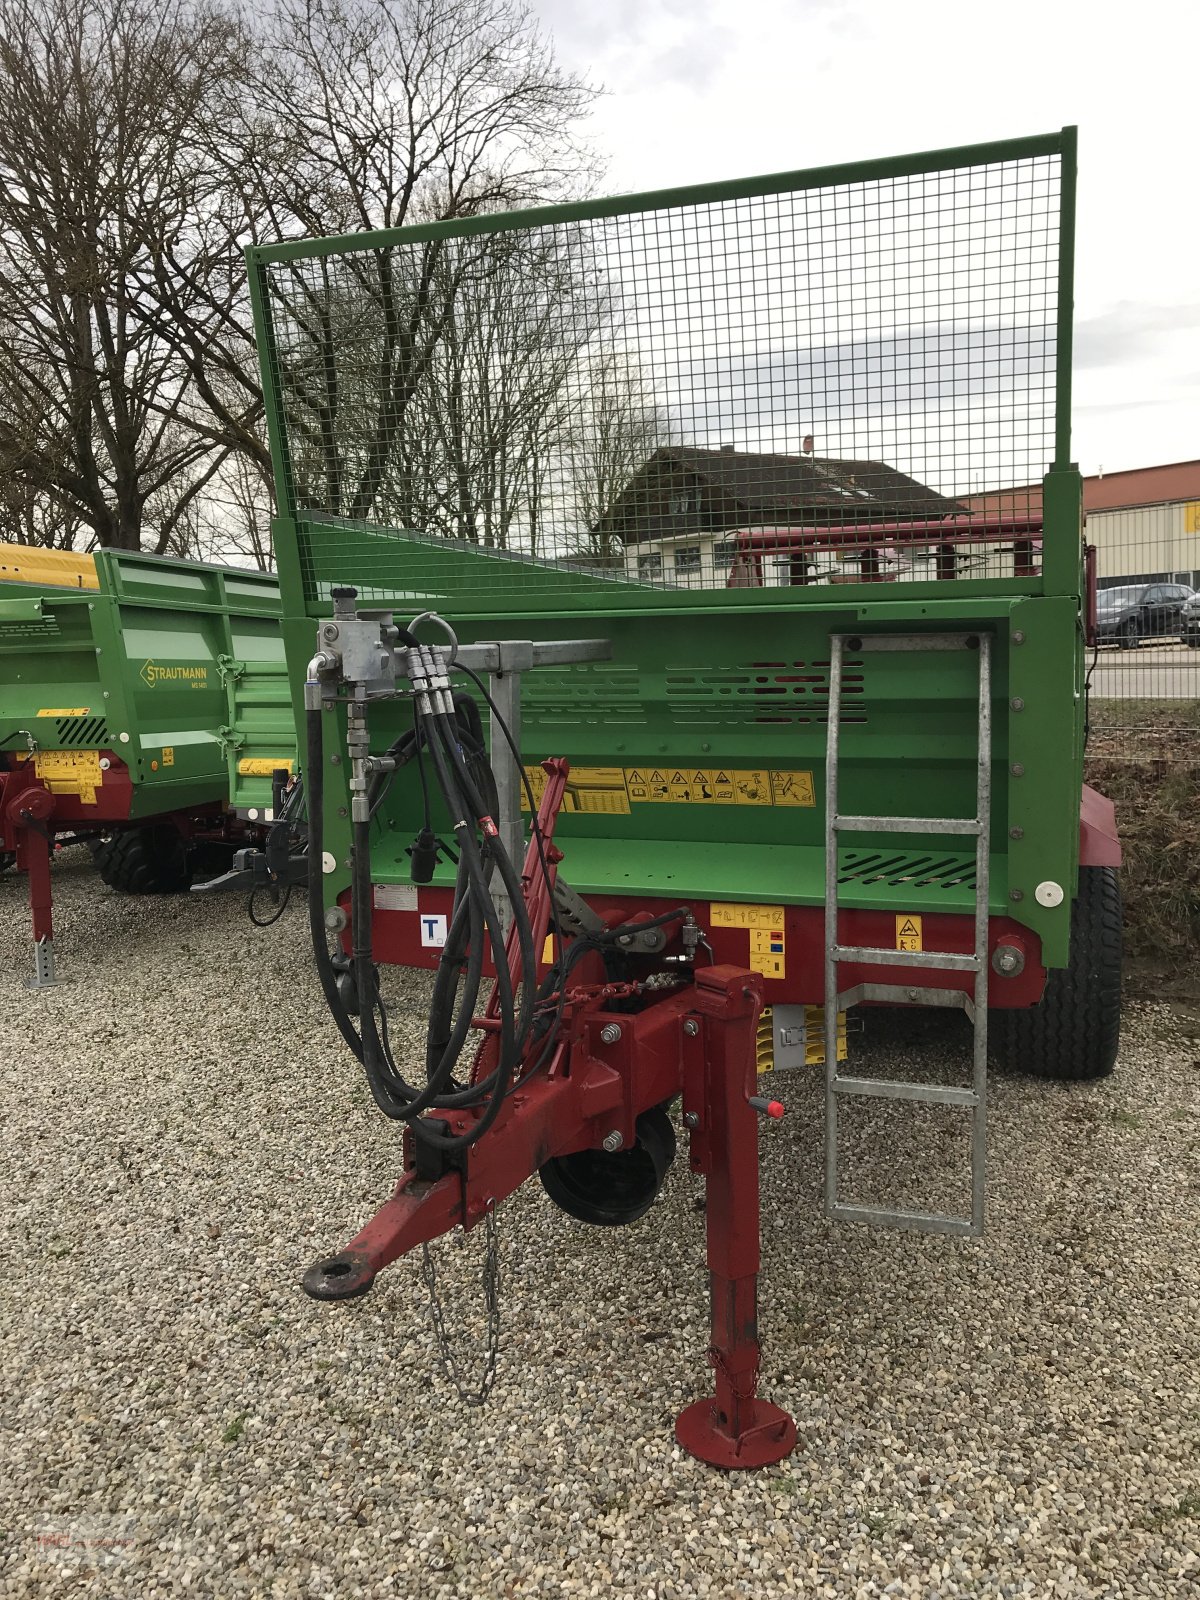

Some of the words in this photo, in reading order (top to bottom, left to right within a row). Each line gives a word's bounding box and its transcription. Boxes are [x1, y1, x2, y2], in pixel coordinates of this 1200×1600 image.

[147, 665, 207, 681] STRAUTMANN
[422, 919, 439, 940] T
[756, 931, 762, 940] P
[756, 943, 762, 952] T
